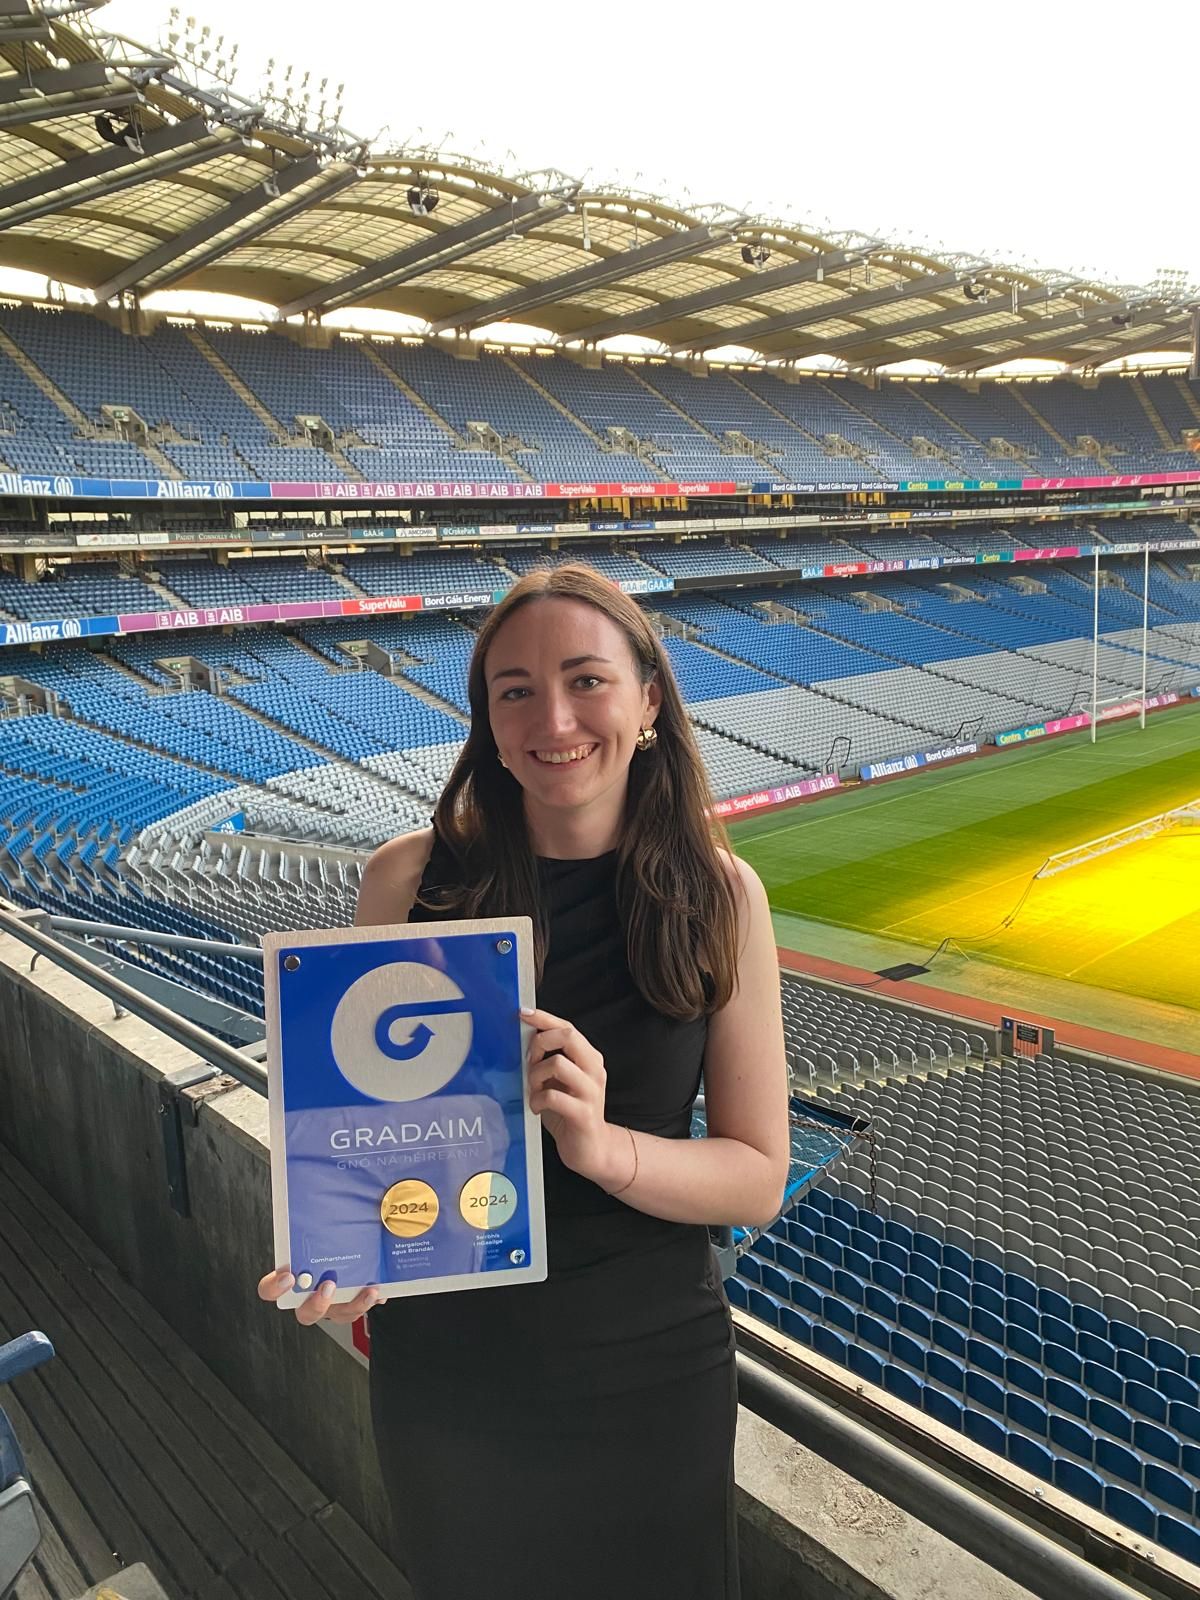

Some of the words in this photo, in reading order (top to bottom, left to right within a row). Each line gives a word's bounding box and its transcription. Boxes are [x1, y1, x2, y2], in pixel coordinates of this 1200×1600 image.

[0, 473, 52, 495] Allianz
[157, 480, 212, 497] Allianz
[336, 484, 358, 497] AIB
[375, 484, 396, 497] AIB
[415, 484, 436, 497] AIB
[453, 484, 473, 496] AIB
[490, 484, 509, 496] AIB
[525, 484, 543, 496] AIB
[559, 484, 597, 497] SuperValu
[621, 484, 655, 495] SuperValu
[678, 484, 709, 494] SuperValu
[797, 484, 816, 492] Energy
[842, 483, 858, 491] Energy
[883, 482, 899, 490] Energy
[907, 481, 928, 490] Centra
[944, 481, 964, 489] Centra
[443, 526, 476, 535] @CrokePark
[908, 559, 930, 569] Allianz
[801, 567, 823, 579] GAA.ie
[647, 579, 673, 591] GAA.ie
[424, 597, 444, 606] Bord
[445, 594, 463, 605] Gáis
[464, 593, 491, 604] Energy
[359, 600, 407, 613] SuperValu
[174, 612, 199, 626] AIB
[220, 608, 243, 622] AIB
[5, 622, 60, 643] Allianz
[925, 750, 941, 762] Bord
[956, 743, 977, 754] Energy
[869, 760, 905, 778] Allianz
[820, 777, 835, 790] AIB
[785, 786, 801, 800] AIB
[733, 793, 769, 810] SuperValu
[330, 1116, 483, 1150] GRADAIM
[376, 1156, 398, 1167] NA
[469, 1194, 509, 1208] 2024
[389, 1202, 429, 1215] 2024
